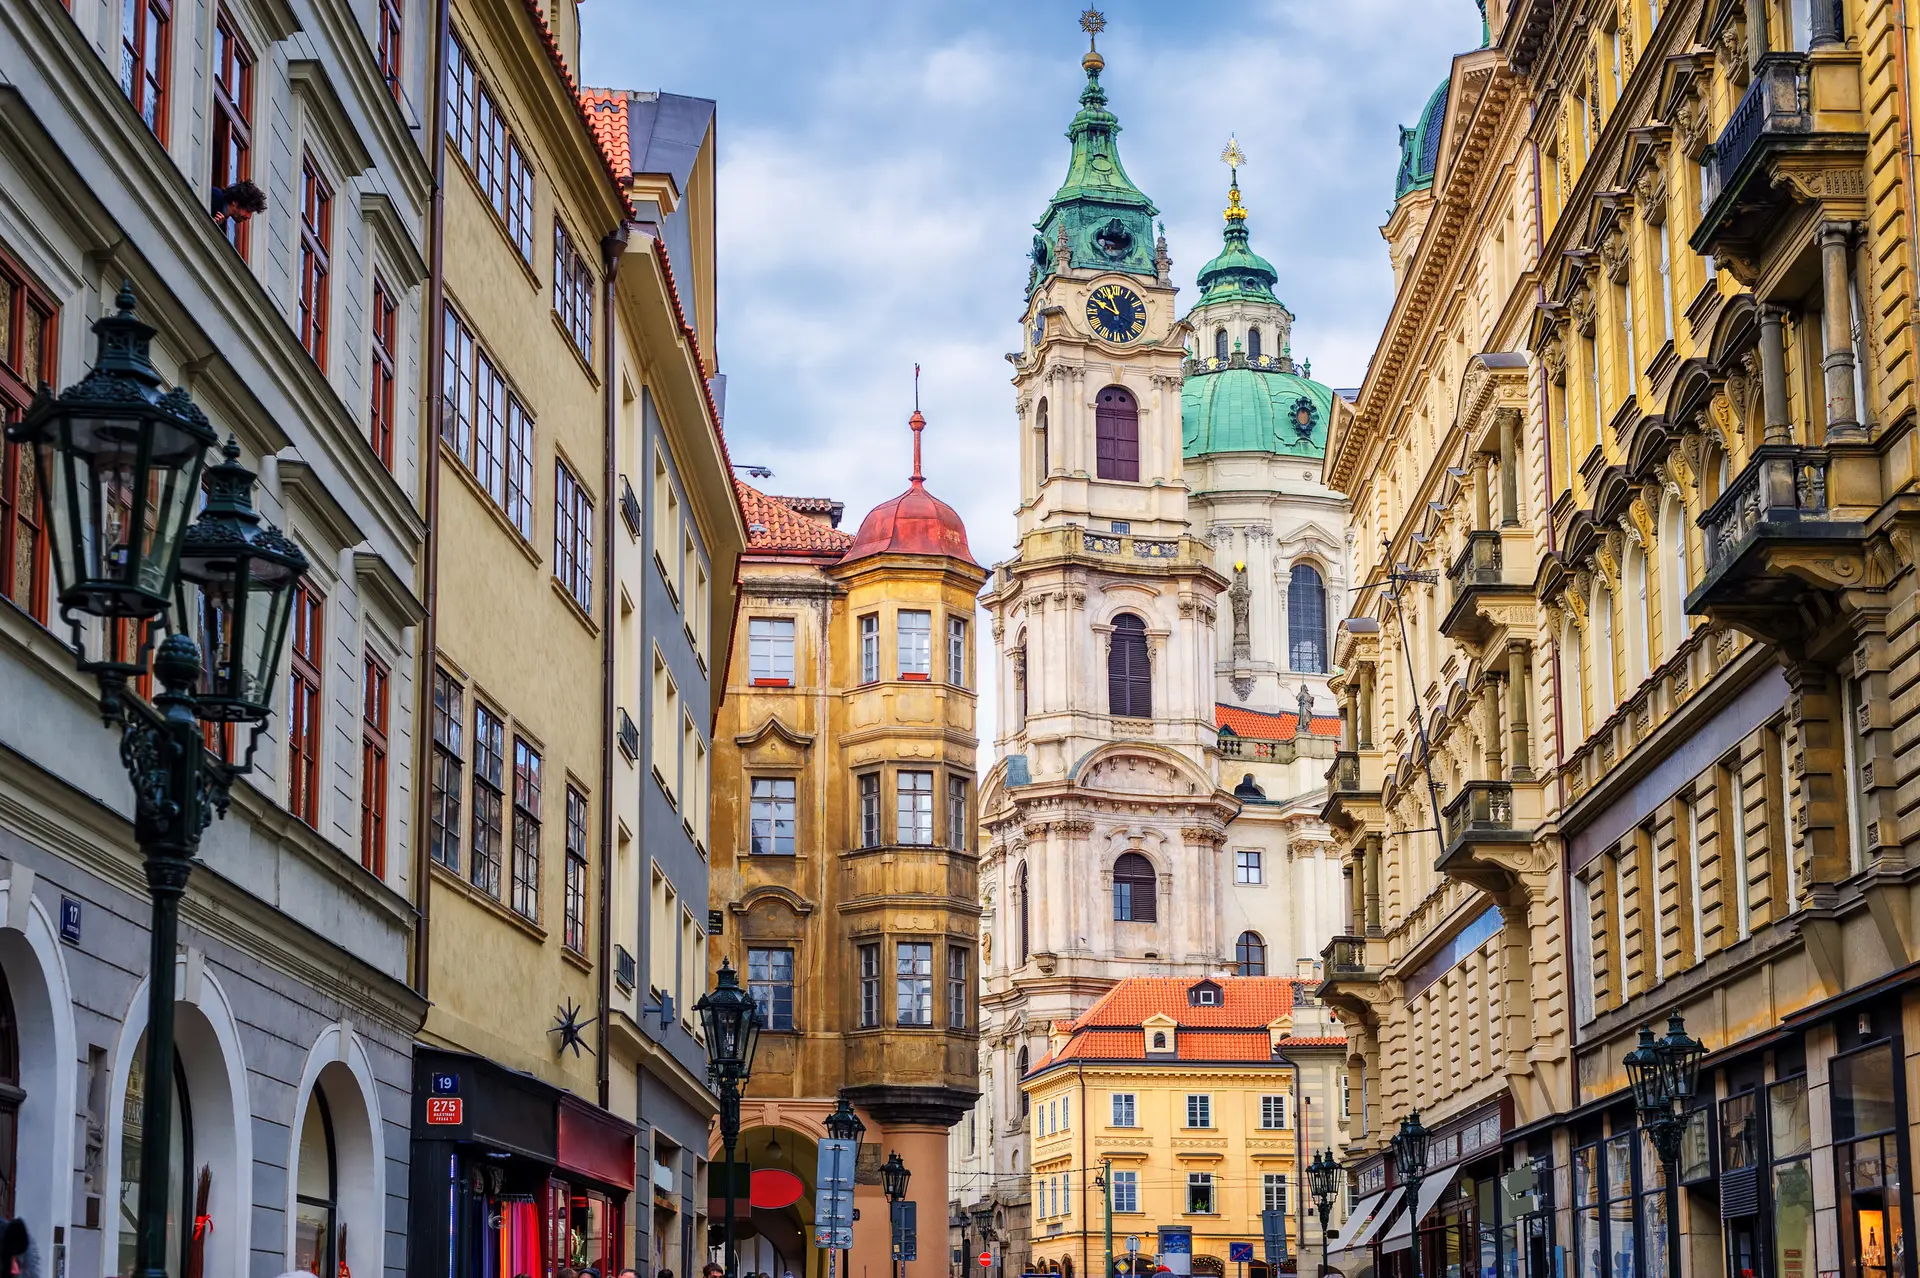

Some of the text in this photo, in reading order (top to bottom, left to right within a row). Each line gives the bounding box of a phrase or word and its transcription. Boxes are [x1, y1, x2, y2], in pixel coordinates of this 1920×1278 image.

[70, 905, 78, 923] 17
[439, 1077, 452, 1089] 19
[433, 1100, 456, 1112] 275
